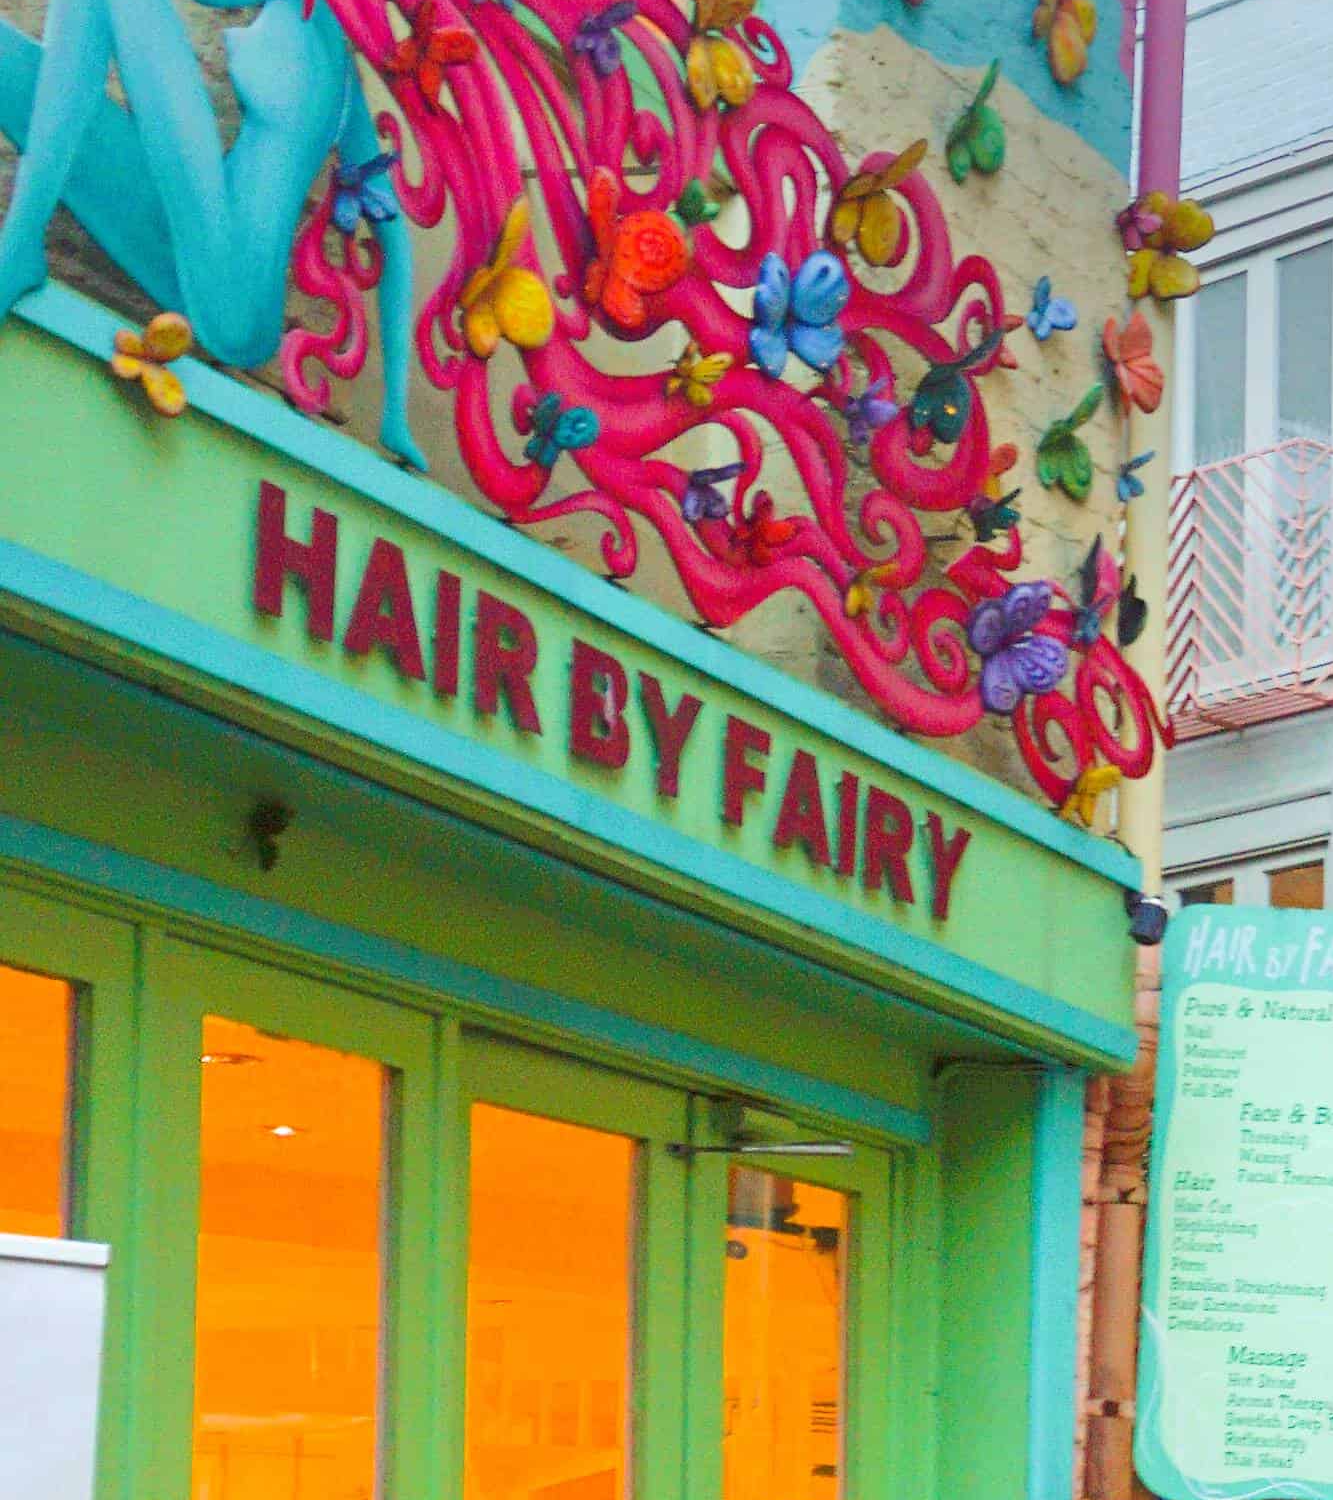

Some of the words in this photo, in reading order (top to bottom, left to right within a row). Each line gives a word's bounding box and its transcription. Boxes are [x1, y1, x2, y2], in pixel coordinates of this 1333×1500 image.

[252, 480, 544, 738] HAIR
[567, 637, 702, 801] BY
[718, 711, 972, 921] FAIRY
[1184, 915, 1257, 979] HAIR
[1185, 997, 1228, 1017] Pure
[1237, 997, 1254, 1018] &
[1262, 1001, 1333, 1022] Natural
[1240, 1102, 1281, 1122] Face
[1287, 1104, 1306, 1124] &
[1174, 1171, 1217, 1191] Hair
[1226, 1346, 1308, 1373] Massage
